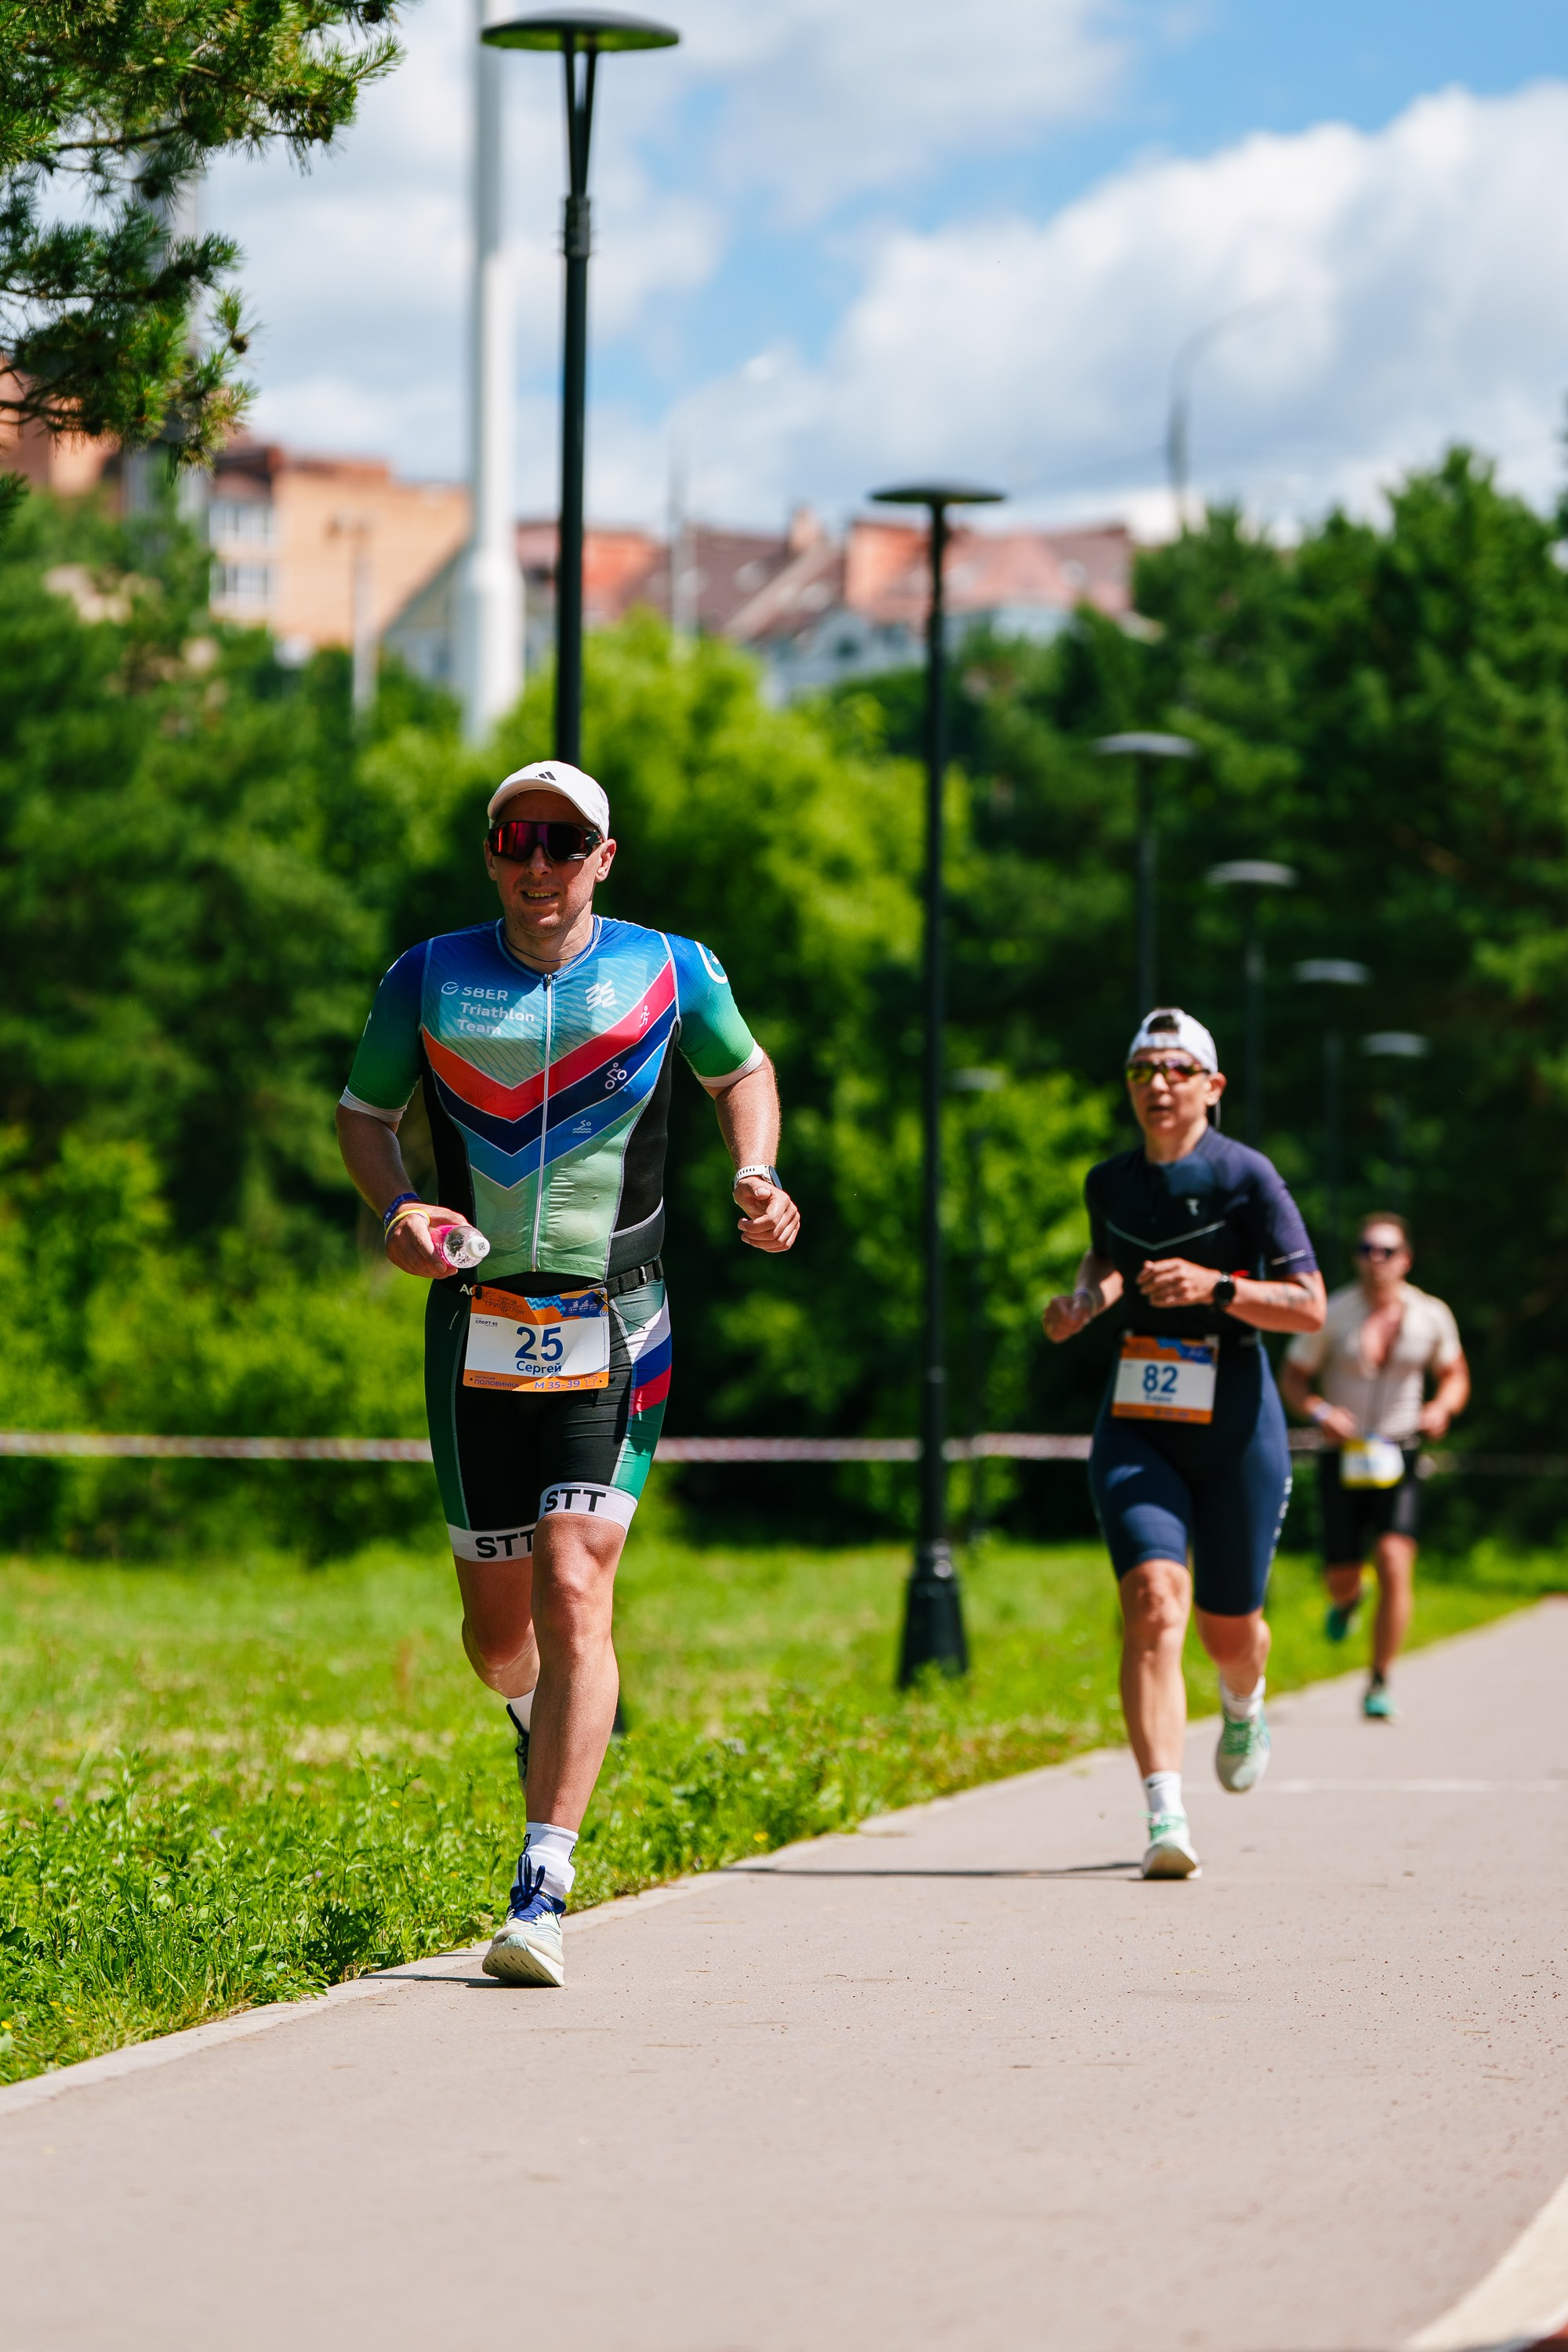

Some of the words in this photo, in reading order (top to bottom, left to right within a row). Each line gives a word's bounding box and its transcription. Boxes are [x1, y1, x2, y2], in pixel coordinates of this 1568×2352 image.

[462, 986, 508, 1001] SBER
[460, 1002, 535, 1022] Triathlon
[457, 1018, 502, 1035] Team
[514, 1326, 564, 1362] 25
[516, 1360, 562, 1375] Сергей
[474, 1378, 519, 1388] ПОЛОВИНКА
[548, 1379, 581, 1390] 35-39
[1142, 1363, 1179, 1393] 82
[544, 1489, 606, 1512] STT
[475, 1530, 534, 1559] STT
